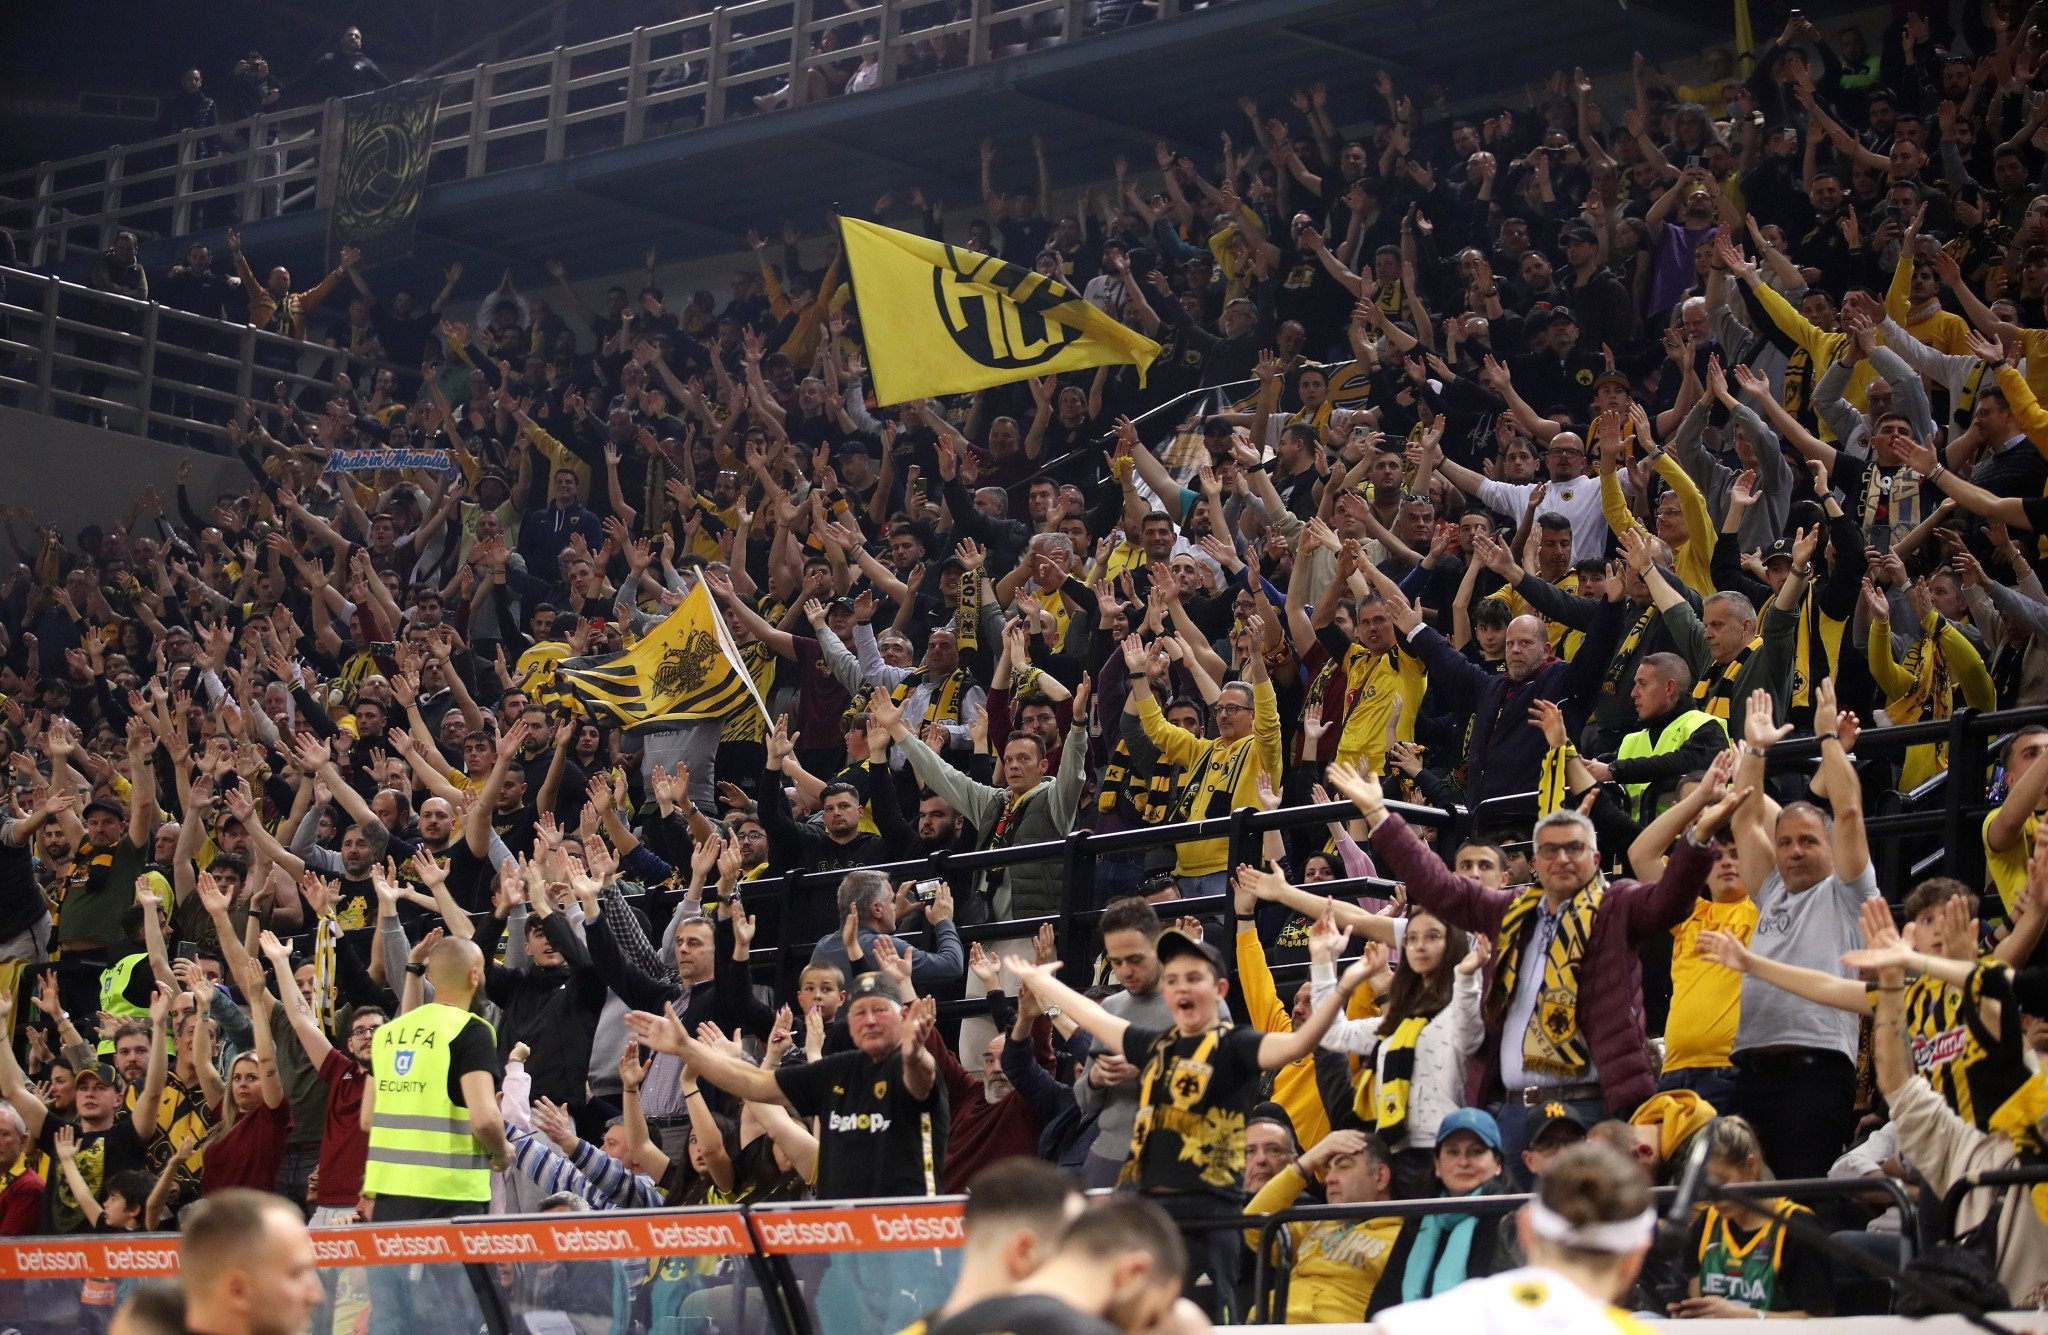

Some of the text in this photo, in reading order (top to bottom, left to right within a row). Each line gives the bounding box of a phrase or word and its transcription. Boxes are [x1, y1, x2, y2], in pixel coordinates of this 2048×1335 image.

[367, 449, 386, 468] in
[385, 1028, 436, 1049] ALFA
[379, 1080, 427, 1093] ECURITY
[459, 1230, 540, 1255] betsson
[551, 1226, 635, 1252] betsson
[648, 1221, 737, 1249] betsson
[758, 1218, 855, 1246] betsson
[312, 1239, 361, 1259] tsson
[371, 1232, 450, 1258] betsson
[14, 1247, 89, 1271] betsson
[103, 1246, 181, 1270] betsson
